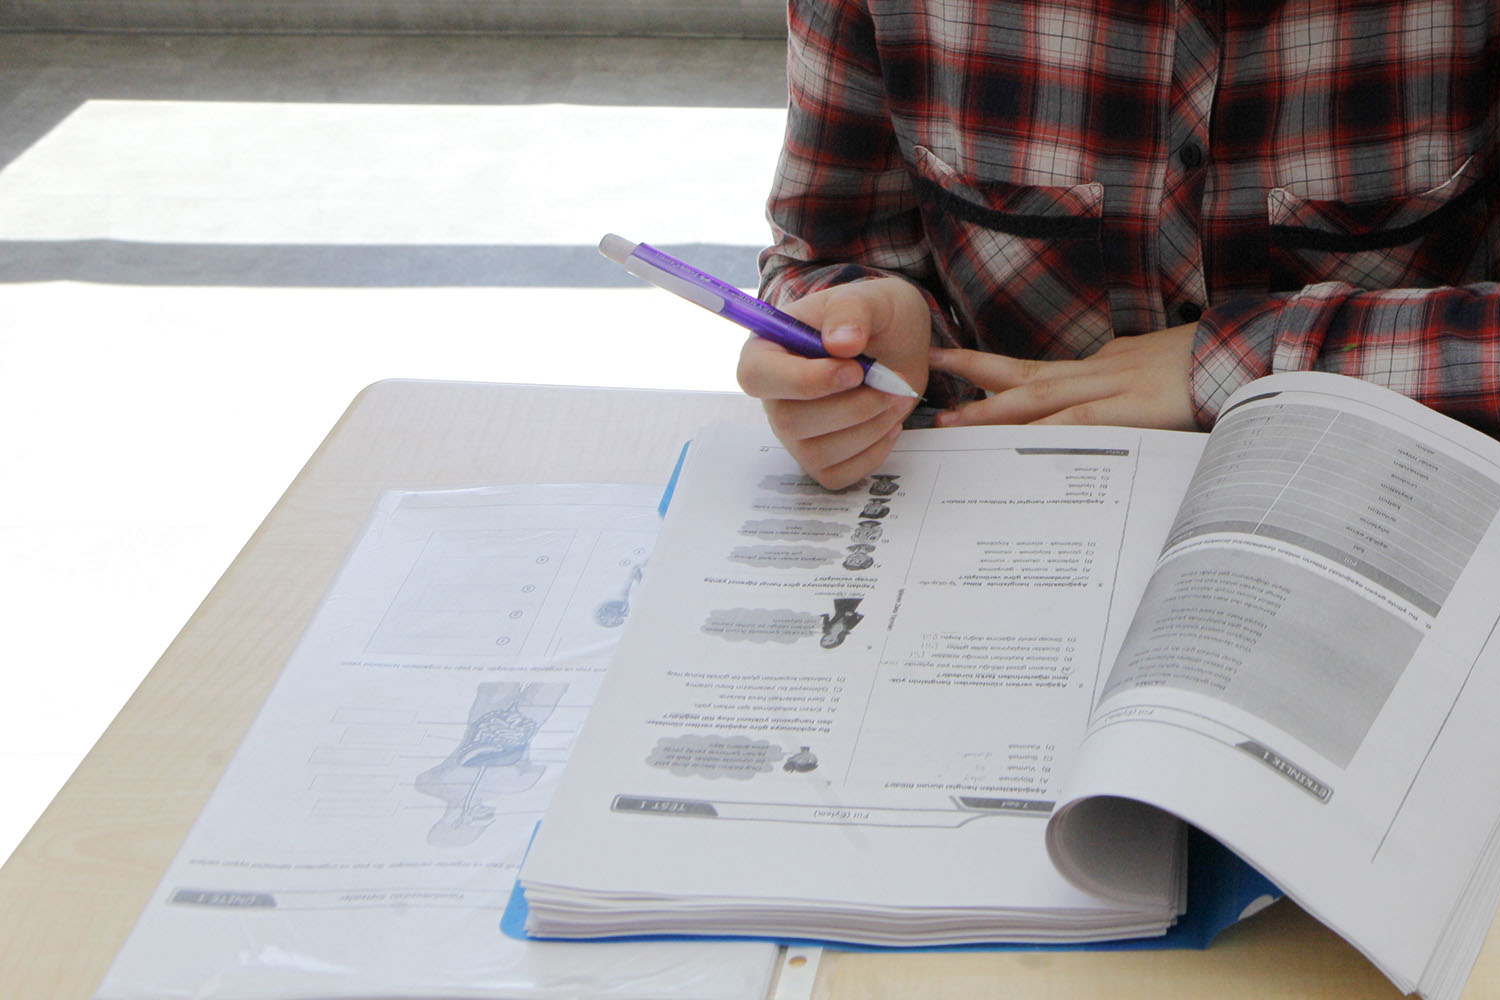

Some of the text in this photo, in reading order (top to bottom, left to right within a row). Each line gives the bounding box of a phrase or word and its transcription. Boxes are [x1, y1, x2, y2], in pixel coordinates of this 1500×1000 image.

[652, 801, 686, 812] TEST
[813, 810, 870, 820] Fiil (Eylem)
